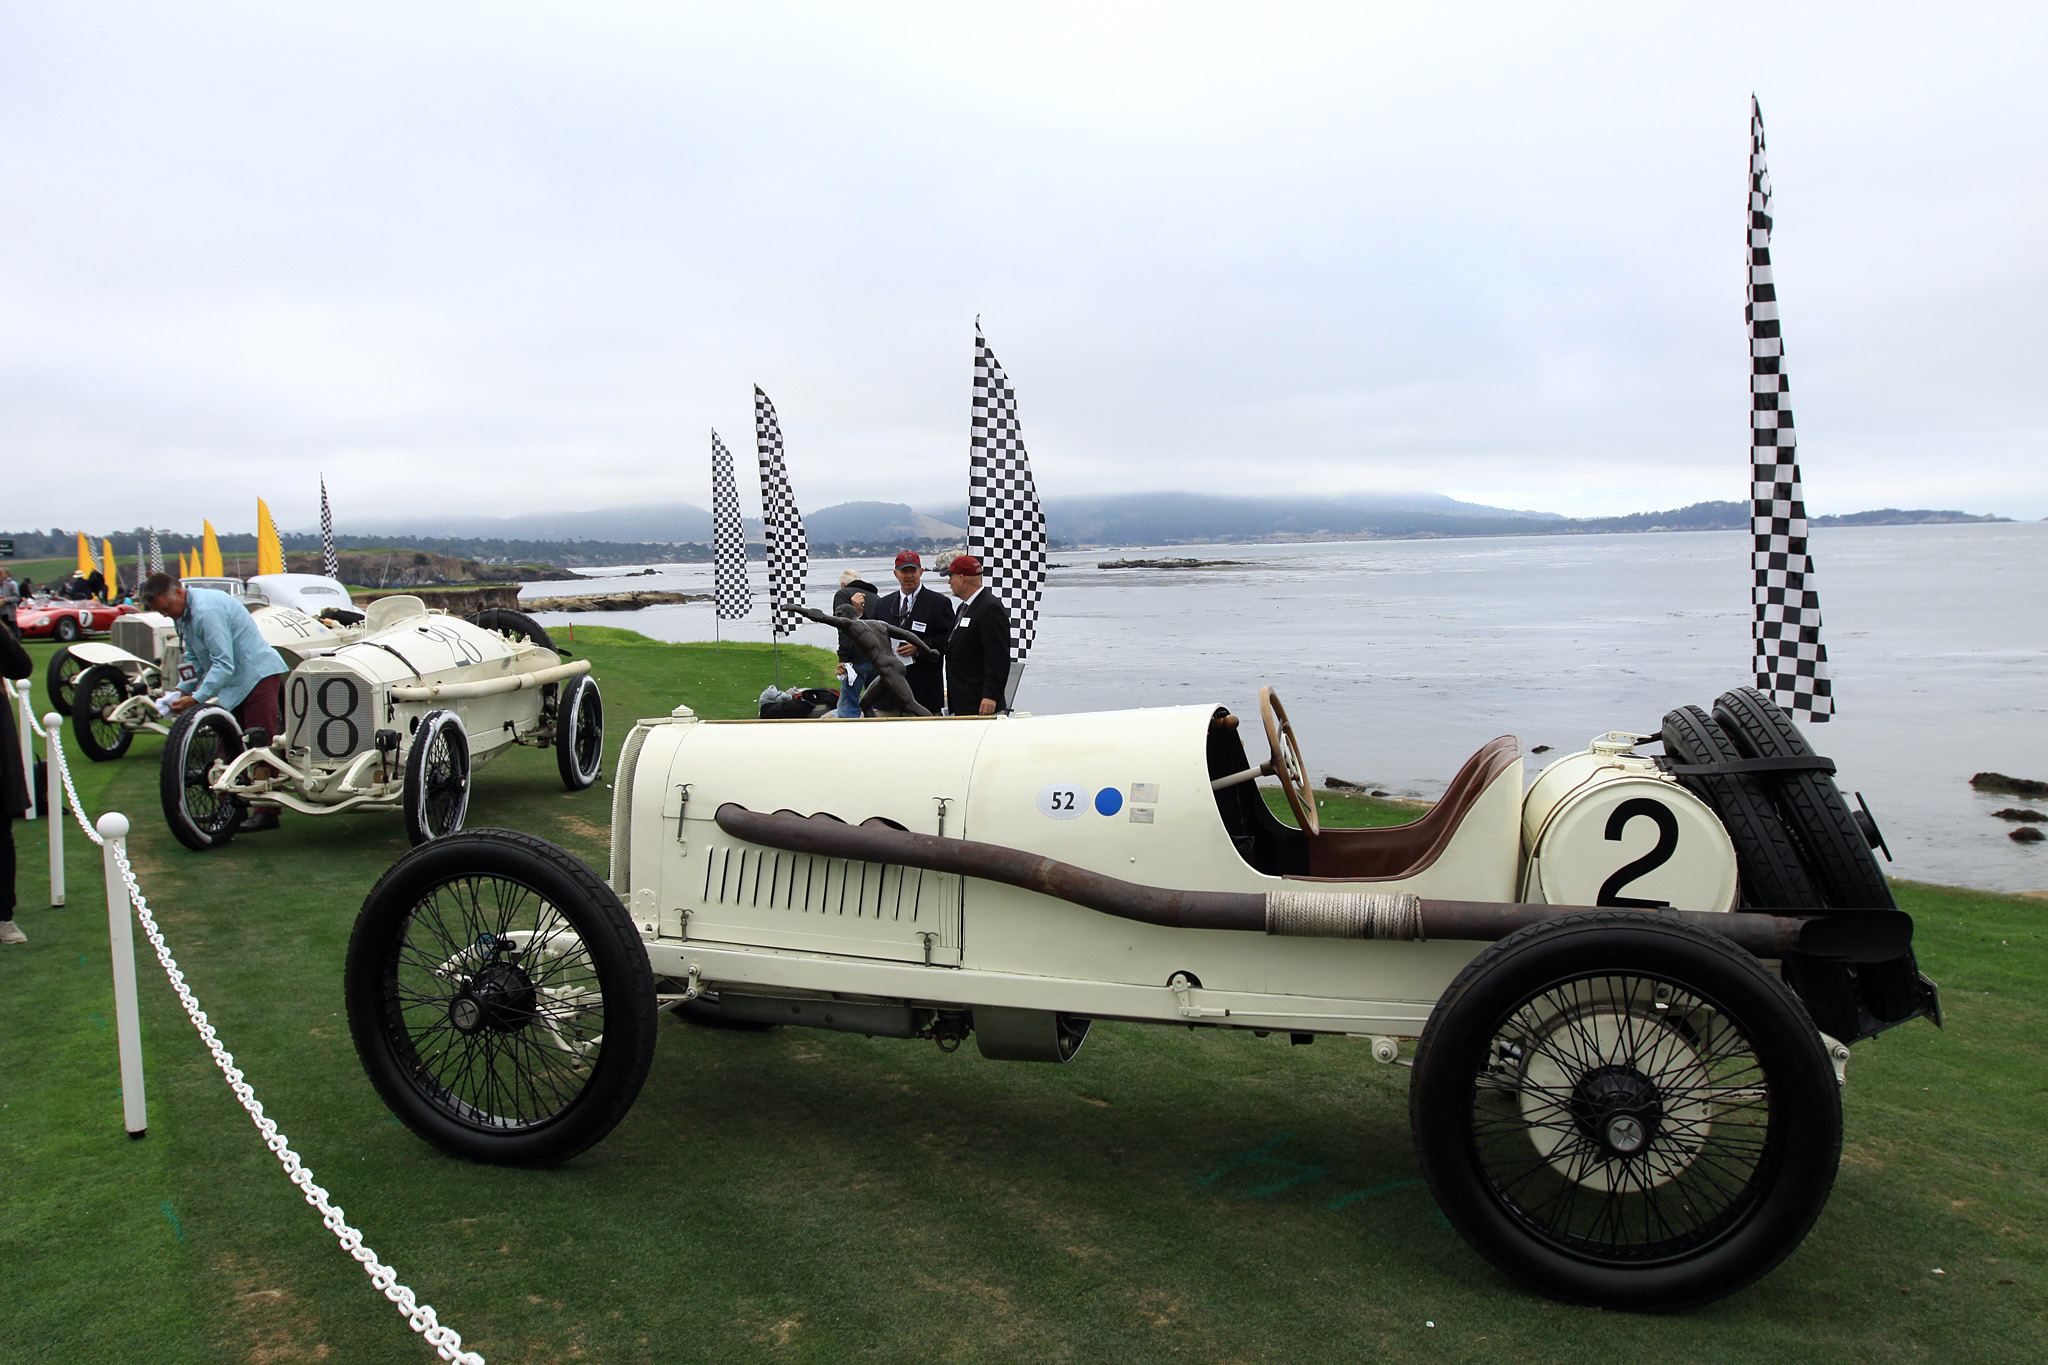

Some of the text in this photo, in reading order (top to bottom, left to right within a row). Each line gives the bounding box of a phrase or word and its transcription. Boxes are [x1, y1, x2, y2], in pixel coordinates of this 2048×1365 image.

[80, 611, 88, 625] 7
[1051, 791, 1075, 810] 52
[1595, 797, 1679, 909] 2
